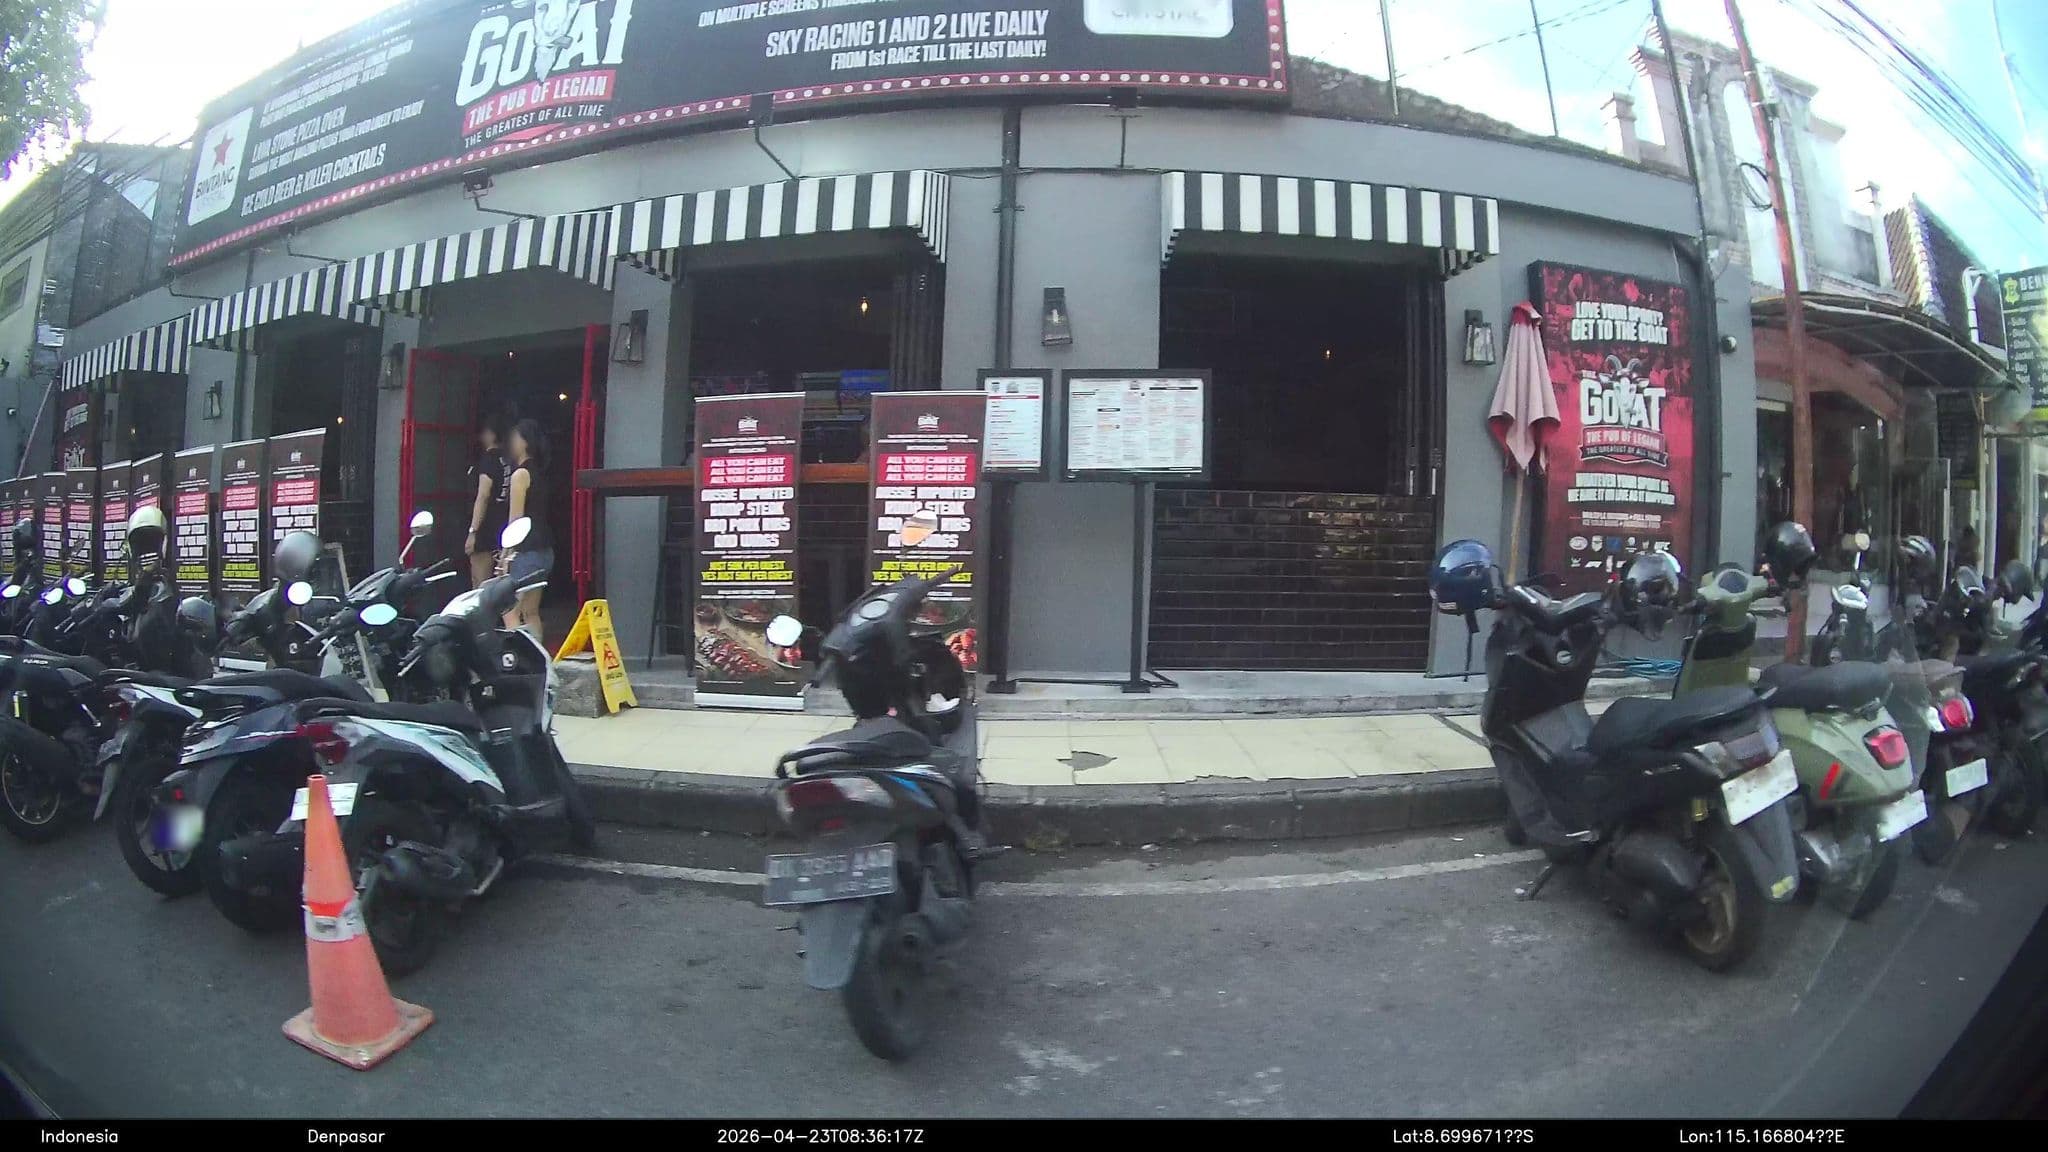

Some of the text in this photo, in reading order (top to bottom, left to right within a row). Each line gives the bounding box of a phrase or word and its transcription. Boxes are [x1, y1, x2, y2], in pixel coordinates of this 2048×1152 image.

[698, 11, 715, 27] ON
[715, 2, 768, 25] MULTIPLE
[768, 0, 819, 16] SCREENS
[766, 10, 1049, 57] SKY RACING 1 AND 2 LIVE DAILY
[830, 39, 1047, 70] FROM 1st RACE TILL THE LAST DAILY!
[469, 76, 608, 129] THE PUB OF LEGIAN
[297, 118, 320, 143] PIZZA
[464, 105, 604, 149] THE GREATEST OF ALL TIME
[332, 143, 387, 182] COCKTAILS
[1571, 319, 1595, 341] GET
[1596, 319, 1613, 341] TO
[1614, 320, 1638, 341] THE
[1580, 378, 1666, 432] GOAT
